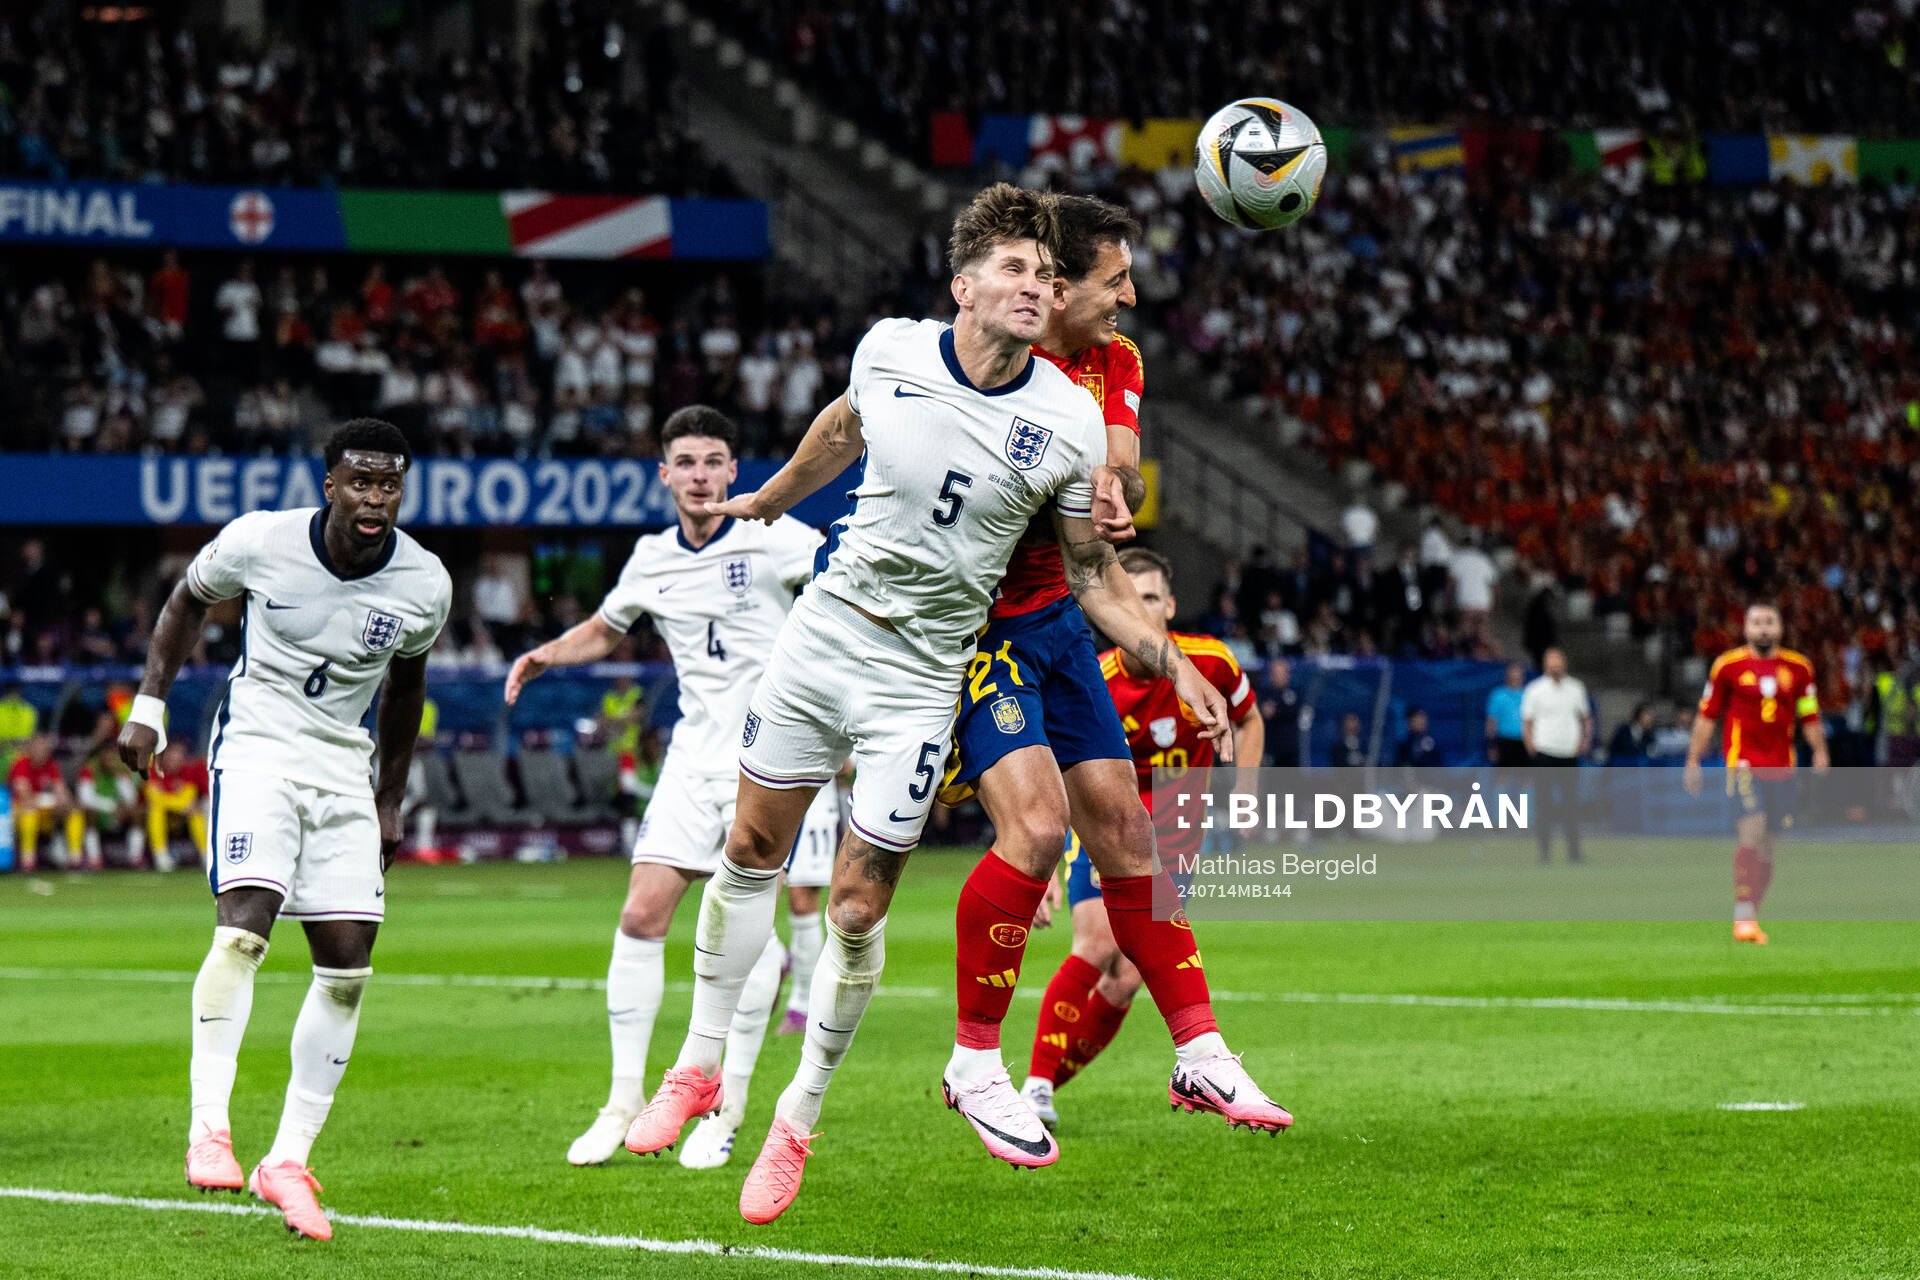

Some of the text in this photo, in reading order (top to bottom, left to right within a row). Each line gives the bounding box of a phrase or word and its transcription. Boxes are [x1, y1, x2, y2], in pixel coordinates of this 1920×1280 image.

[0, 186, 154, 237] FINAL
[140, 457, 322, 525] UEFA
[932, 469, 973, 528] 5
[707, 620, 728, 662] 4
[303, 659, 334, 700] 6
[967, 639, 1024, 704] 21
[908, 741, 941, 803] 5
[1149, 747, 1188, 782] 10
[809, 828, 830, 856] 11
